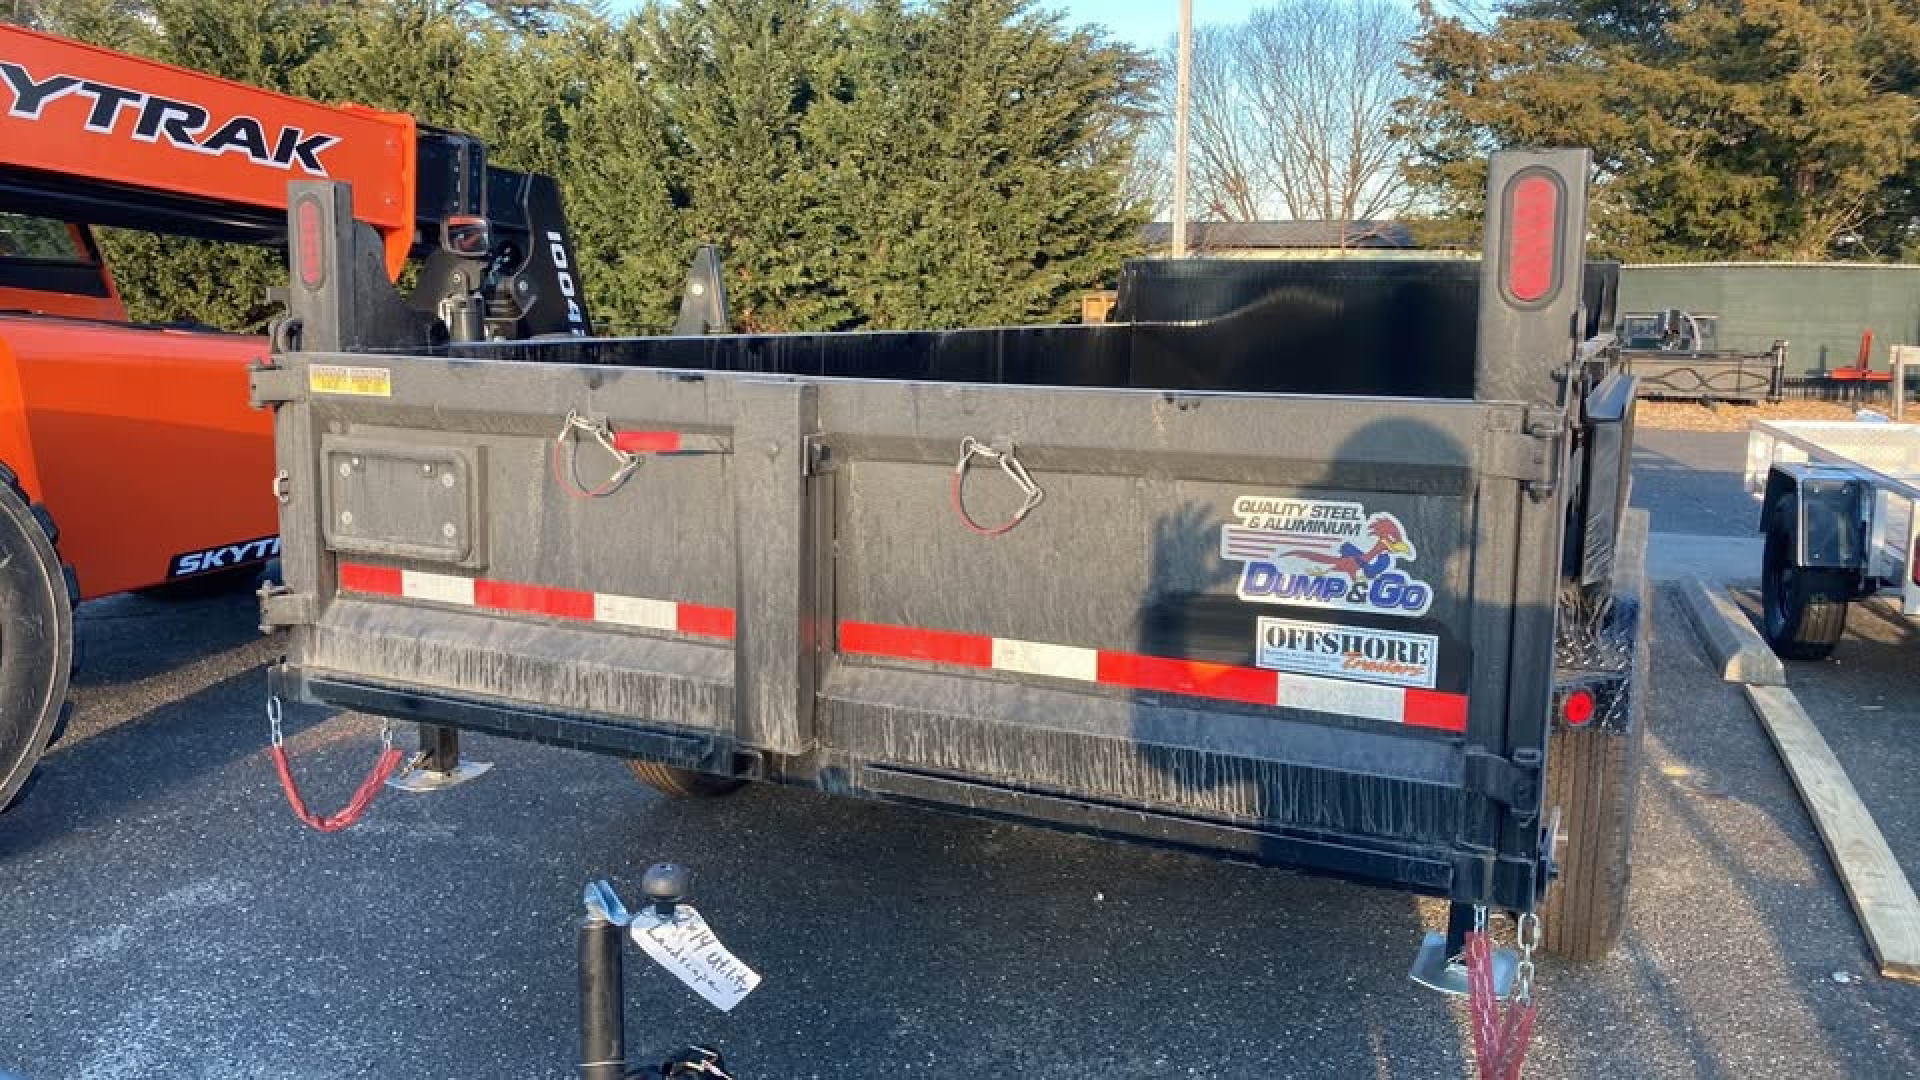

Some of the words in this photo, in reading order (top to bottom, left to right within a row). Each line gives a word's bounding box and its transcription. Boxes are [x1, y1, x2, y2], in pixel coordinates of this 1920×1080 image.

[546, 231, 586, 337] 1004
[1237, 501, 1308, 516] QUALITY
[1310, 505, 1361, 520] STEEL
[1263, 518, 1361, 536] ALUMINUM
[1265, 625, 1428, 665] OFFSHORE
